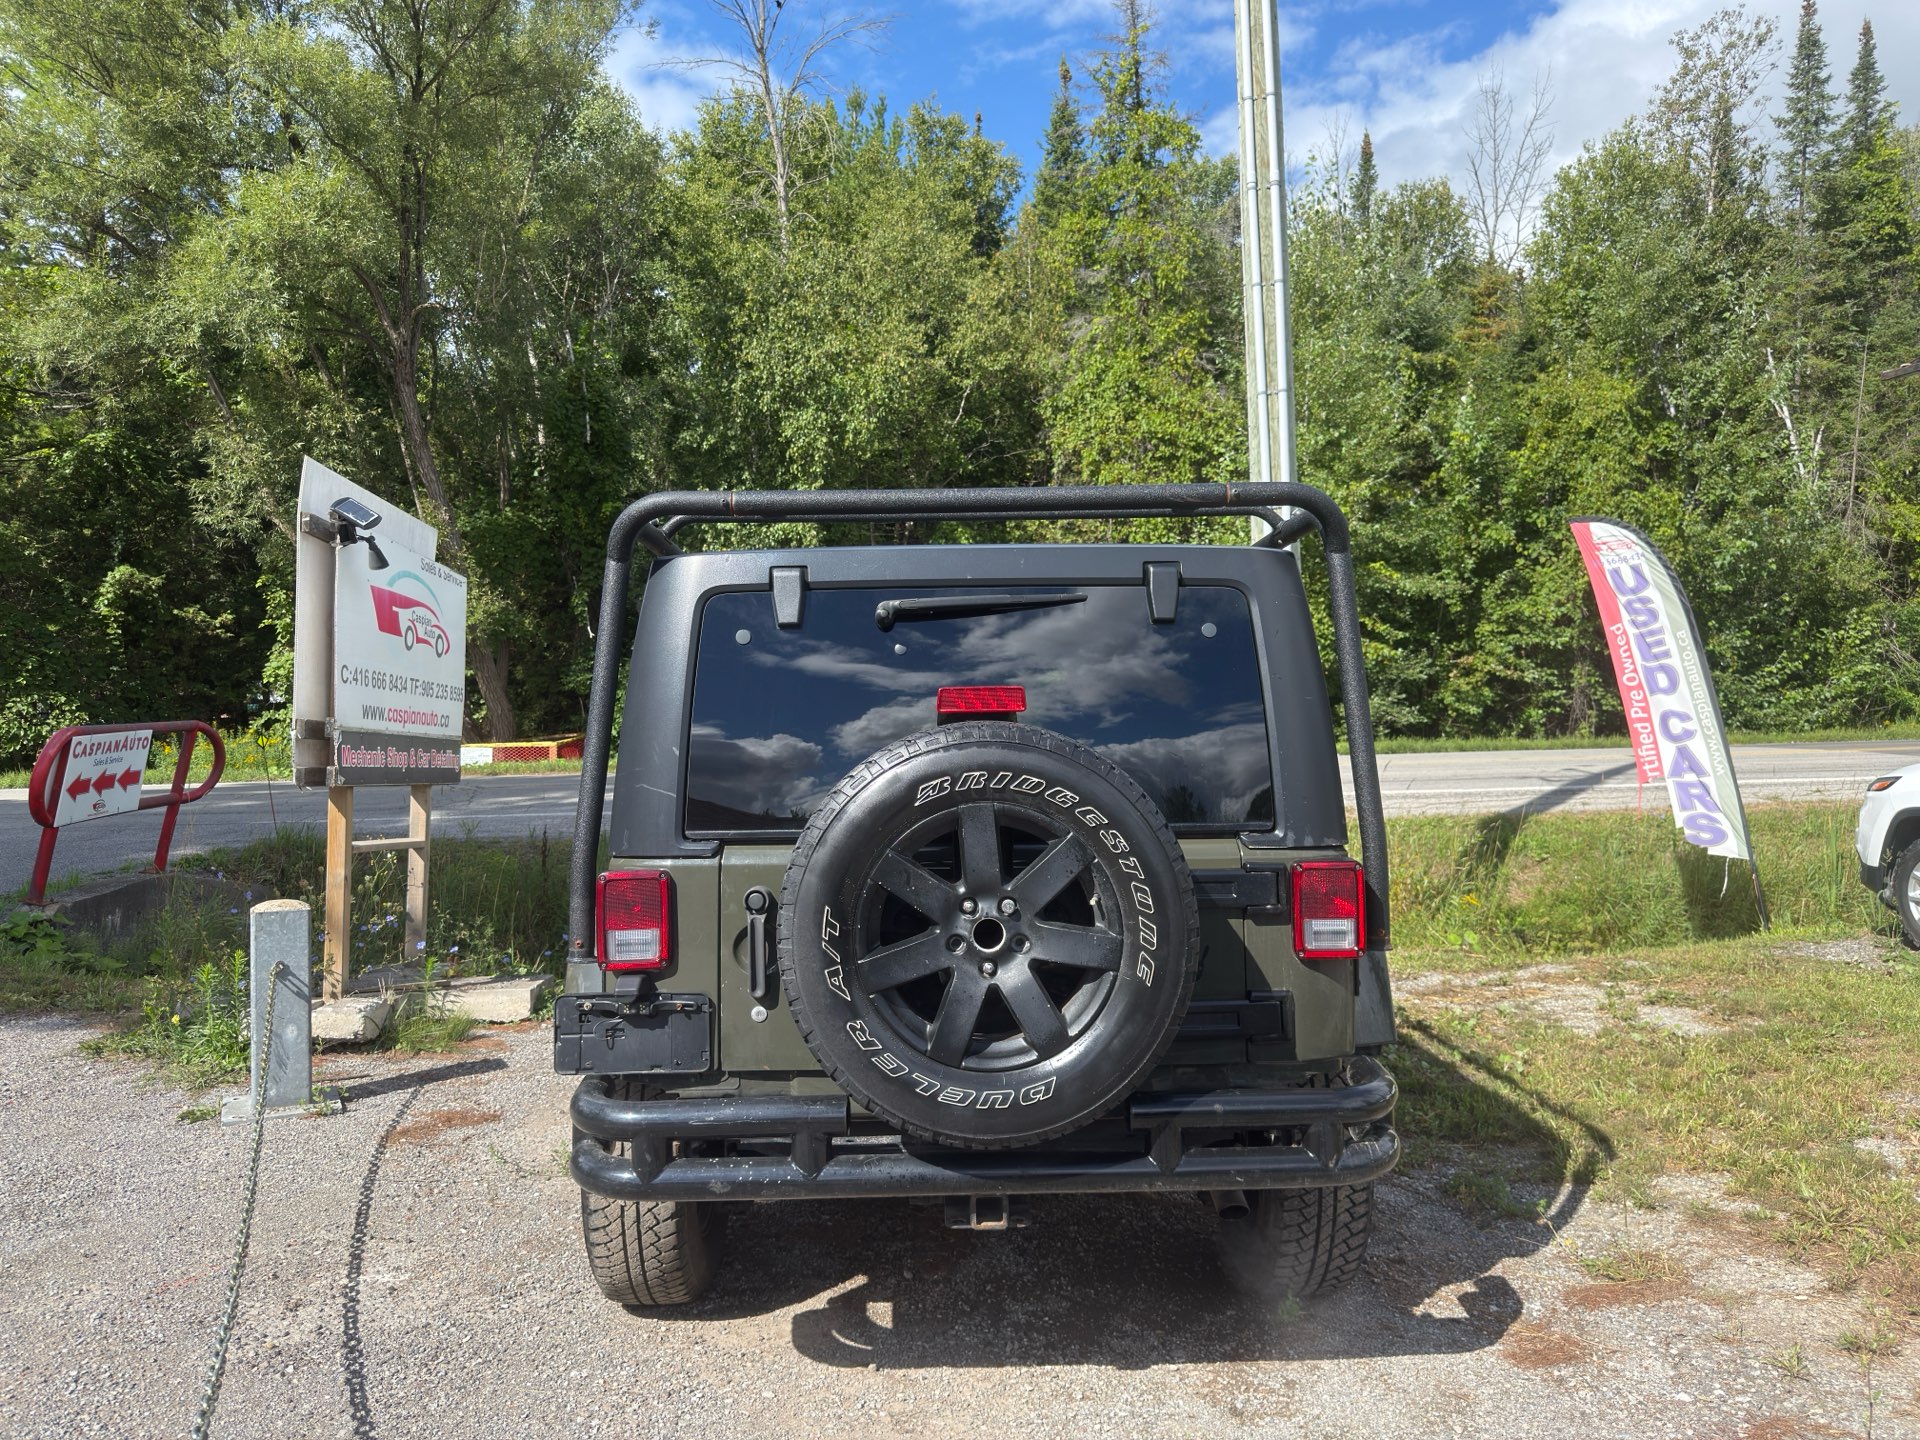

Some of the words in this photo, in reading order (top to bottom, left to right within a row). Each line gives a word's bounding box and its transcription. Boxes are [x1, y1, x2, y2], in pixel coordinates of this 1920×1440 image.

[411, 610, 432, 628] Caspian
[424, 626, 436, 639] Auto
[1610, 622, 1640, 688] Owned
[341, 664, 369, 688] C:416
[371, 670, 387, 690] 666
[388, 673, 408, 693] 8434
[409, 677, 435, 698] TF:905
[435, 682, 449, 700] 235
[449, 685, 464, 703] 8595
[1675, 629, 1725, 777] www.caspianauto.ca
[362, 704, 450, 728] www.caspianauto.ca
[1606, 561, 1680, 699] USED
[1658, 708, 1728, 848] CARS
[1630, 689, 1649, 719] Pre
[93, 757, 105, 767] Sales
[108, 755, 124, 765] Service
[341, 745, 386, 768] Mechanic
[387, 746, 408, 772] Shop
[409, 748, 416, 768] &
[417, 748, 431, 768] Car
[431, 748, 460, 773] Detailing
[913, 770, 1159, 989] BRIDGESTONE
[819, 905, 853, 1002] A/T
[846, 1018, 1057, 1110] DUELER
